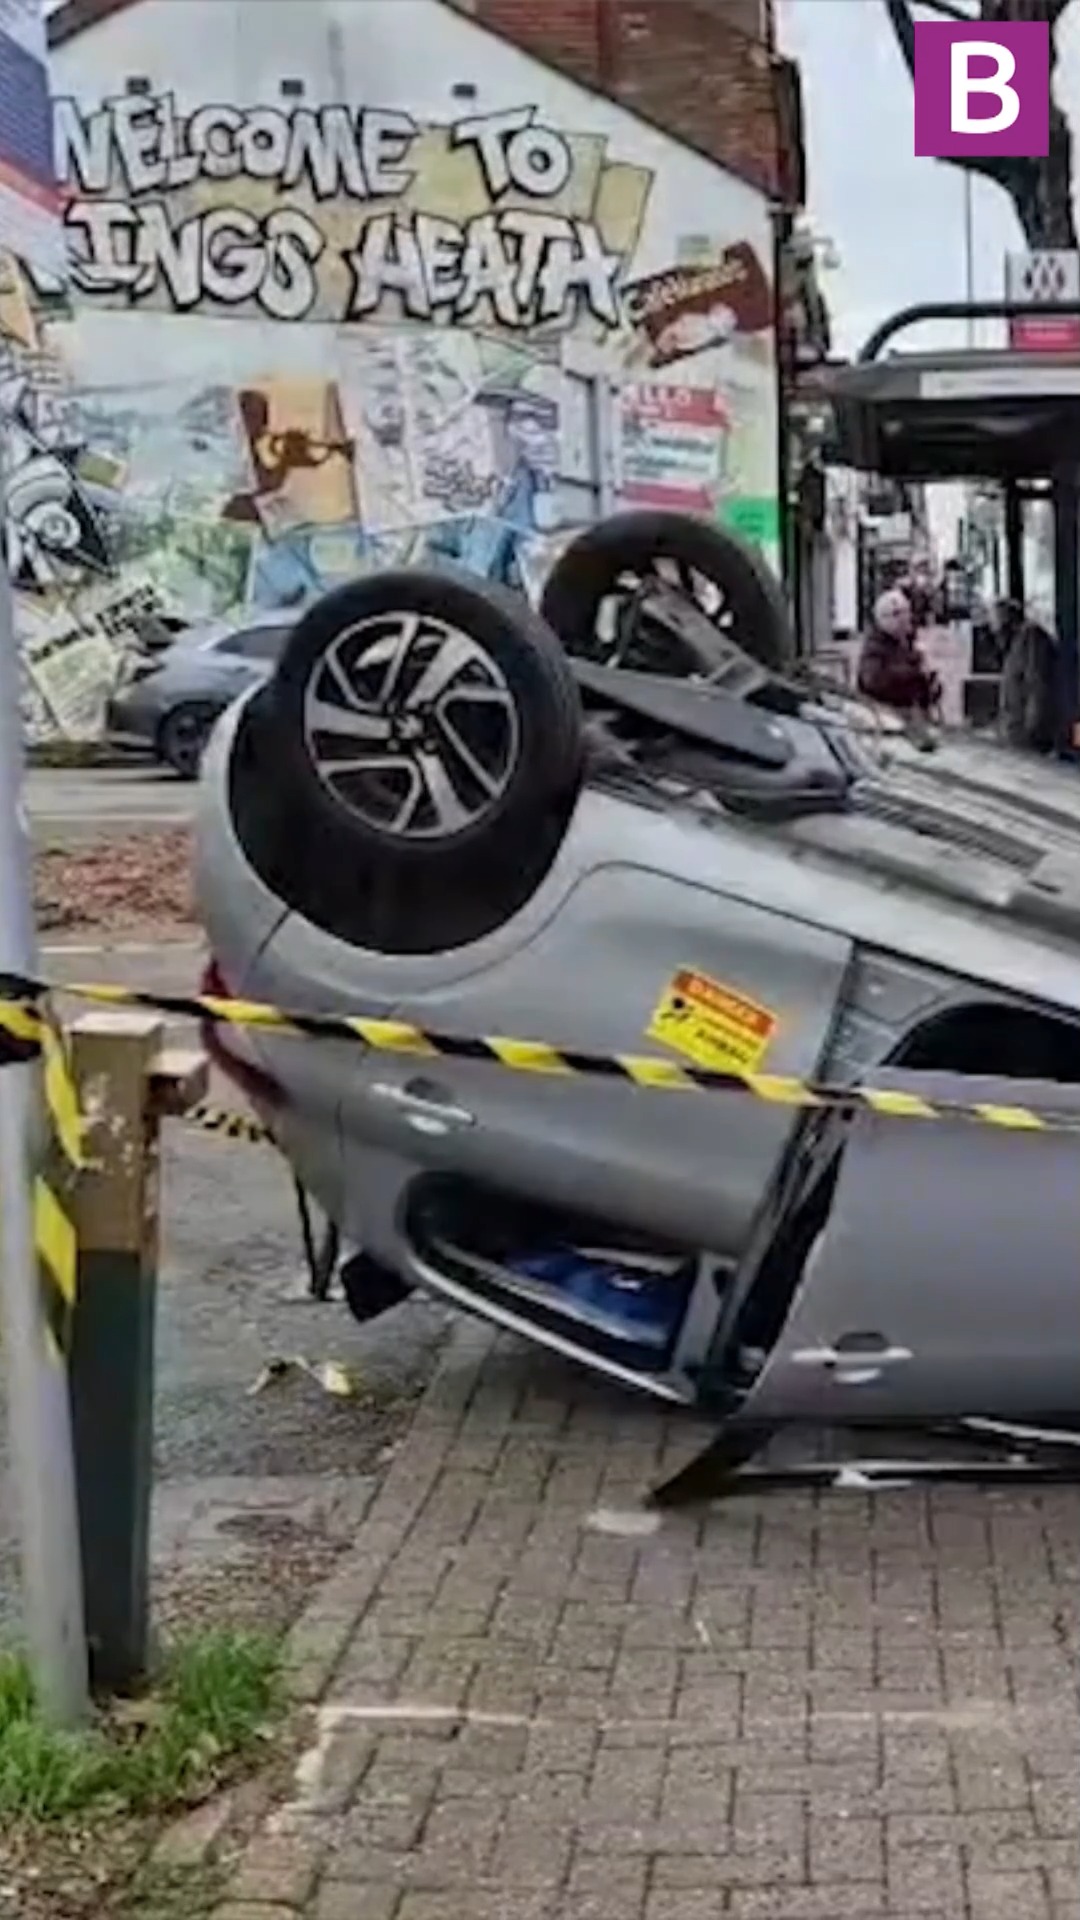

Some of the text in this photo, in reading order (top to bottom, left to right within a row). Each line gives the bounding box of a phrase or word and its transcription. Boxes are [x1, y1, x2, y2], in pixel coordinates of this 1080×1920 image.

[450, 104, 571, 203] TO
[22, 198, 327, 321] INGS
[344, 208, 619, 329] HEATH
